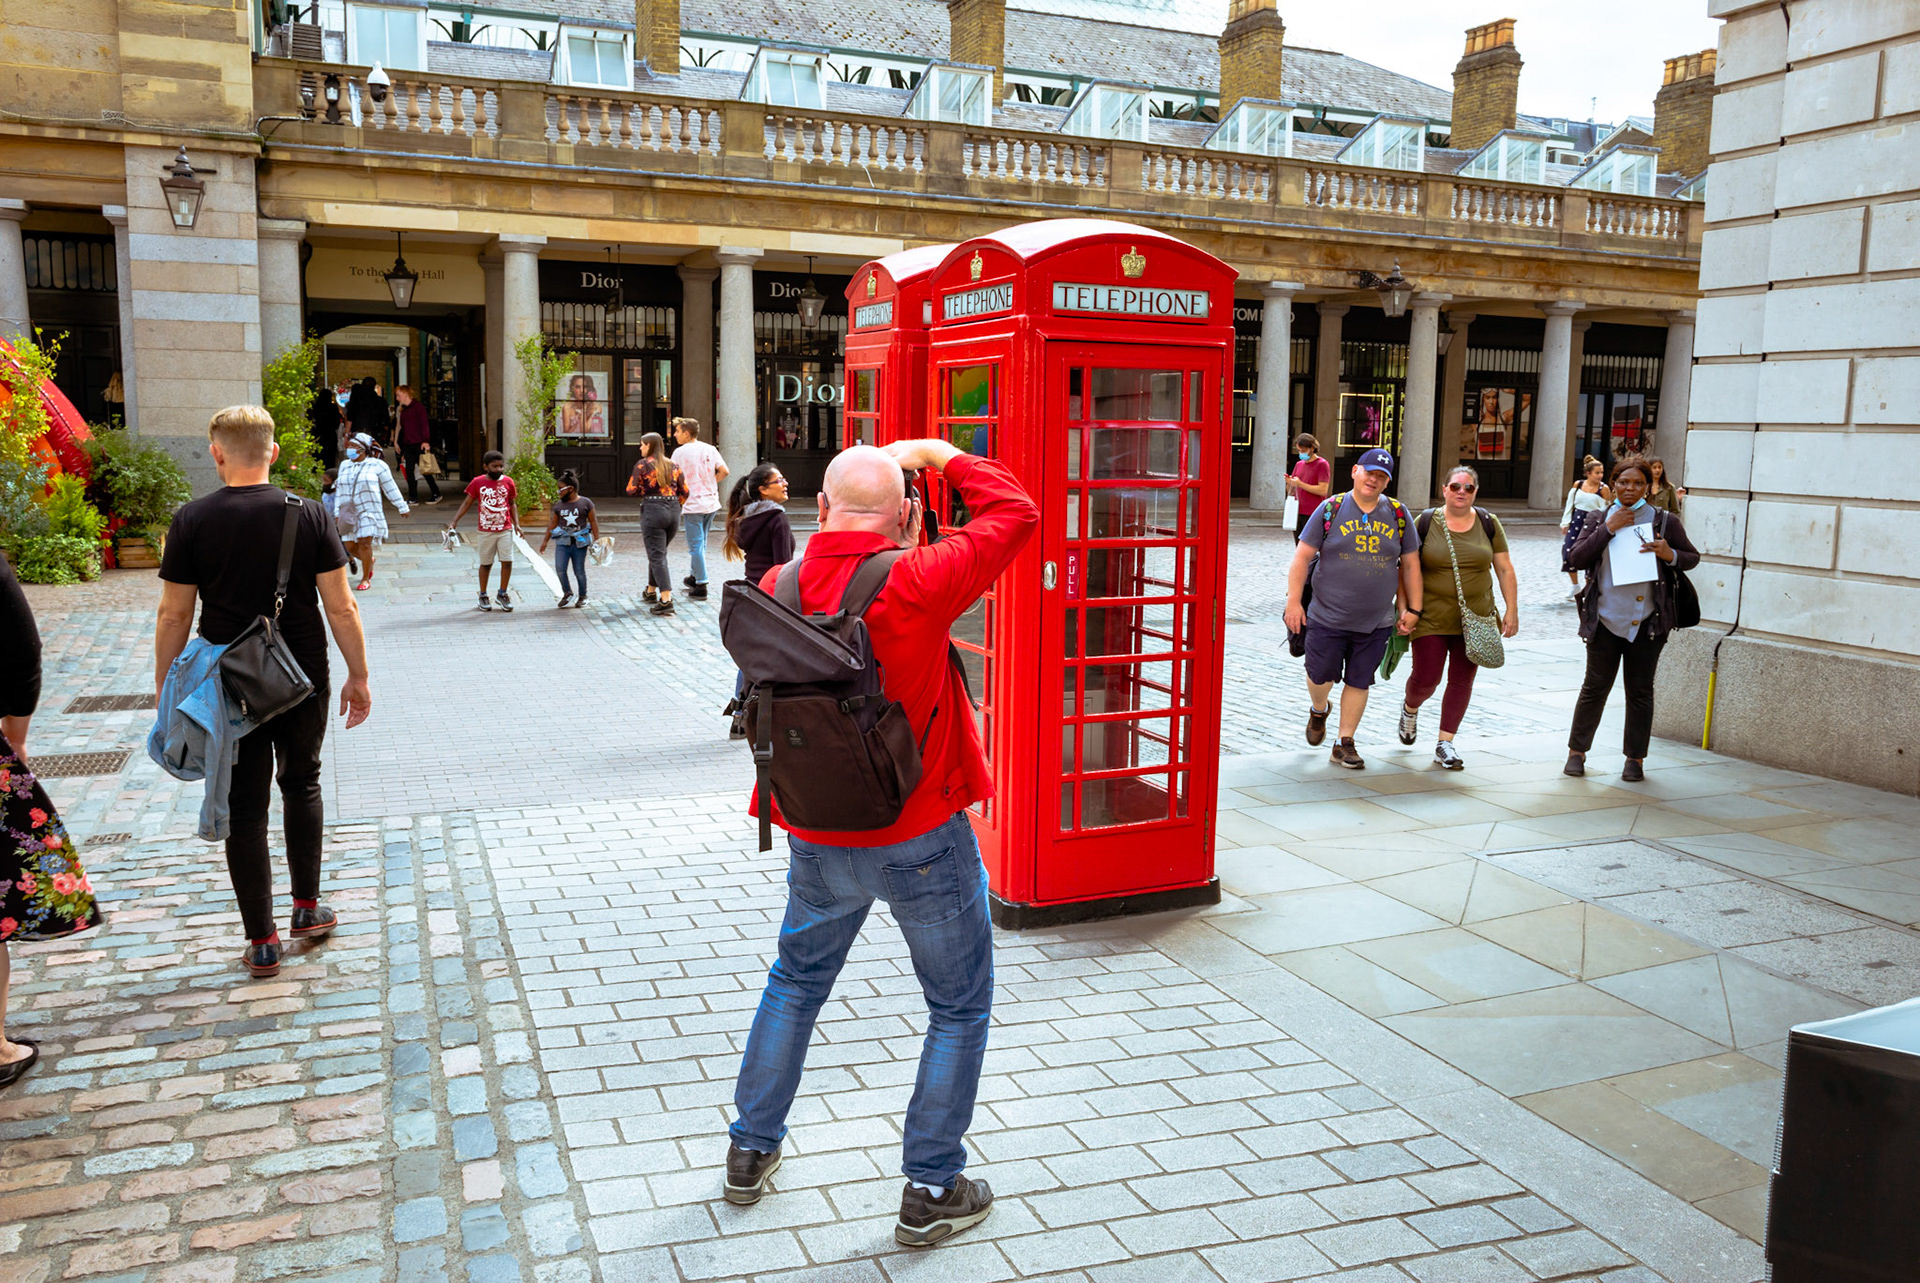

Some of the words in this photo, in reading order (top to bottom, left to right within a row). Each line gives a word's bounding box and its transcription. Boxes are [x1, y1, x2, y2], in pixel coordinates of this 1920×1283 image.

[349, 266, 364, 276] To
[366, 267, 384, 277] the
[422, 270, 445, 280] Hall
[580, 271, 624, 289] Dior
[770, 282, 805, 298] Dio
[946, 285, 1013, 317] TELEPHONE
[1058, 286, 1203, 316] TELEPHONE
[856, 304, 893, 329] TELEPHONE
[573, 507, 579, 515] A
[1355, 534, 1380, 554] 58
[1068, 555, 1076, 594] PULL
